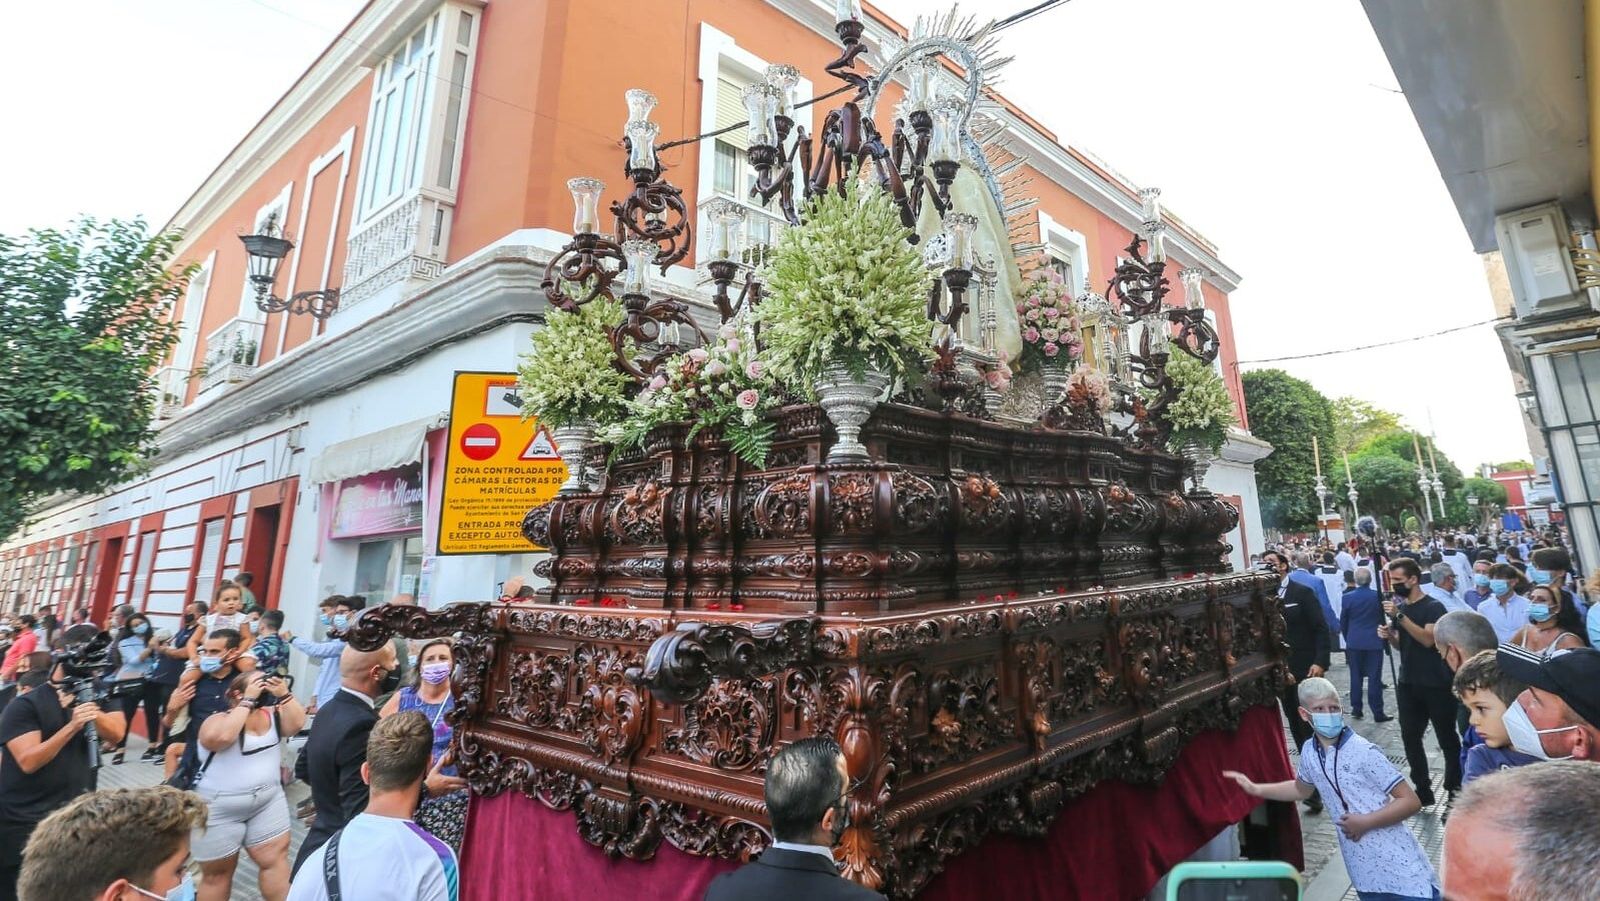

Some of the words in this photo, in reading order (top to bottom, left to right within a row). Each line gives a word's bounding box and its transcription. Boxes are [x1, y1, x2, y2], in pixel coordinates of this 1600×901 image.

[454, 476, 500, 484] CÁMARAS
[502, 476, 549, 484] LECTORAS
[552, 476, 563, 484] DE
[479, 485, 537, 494] MATRÍCULAS
[457, 521, 501, 529] ENTRADA
[448, 531, 492, 540] EXCEPTO
